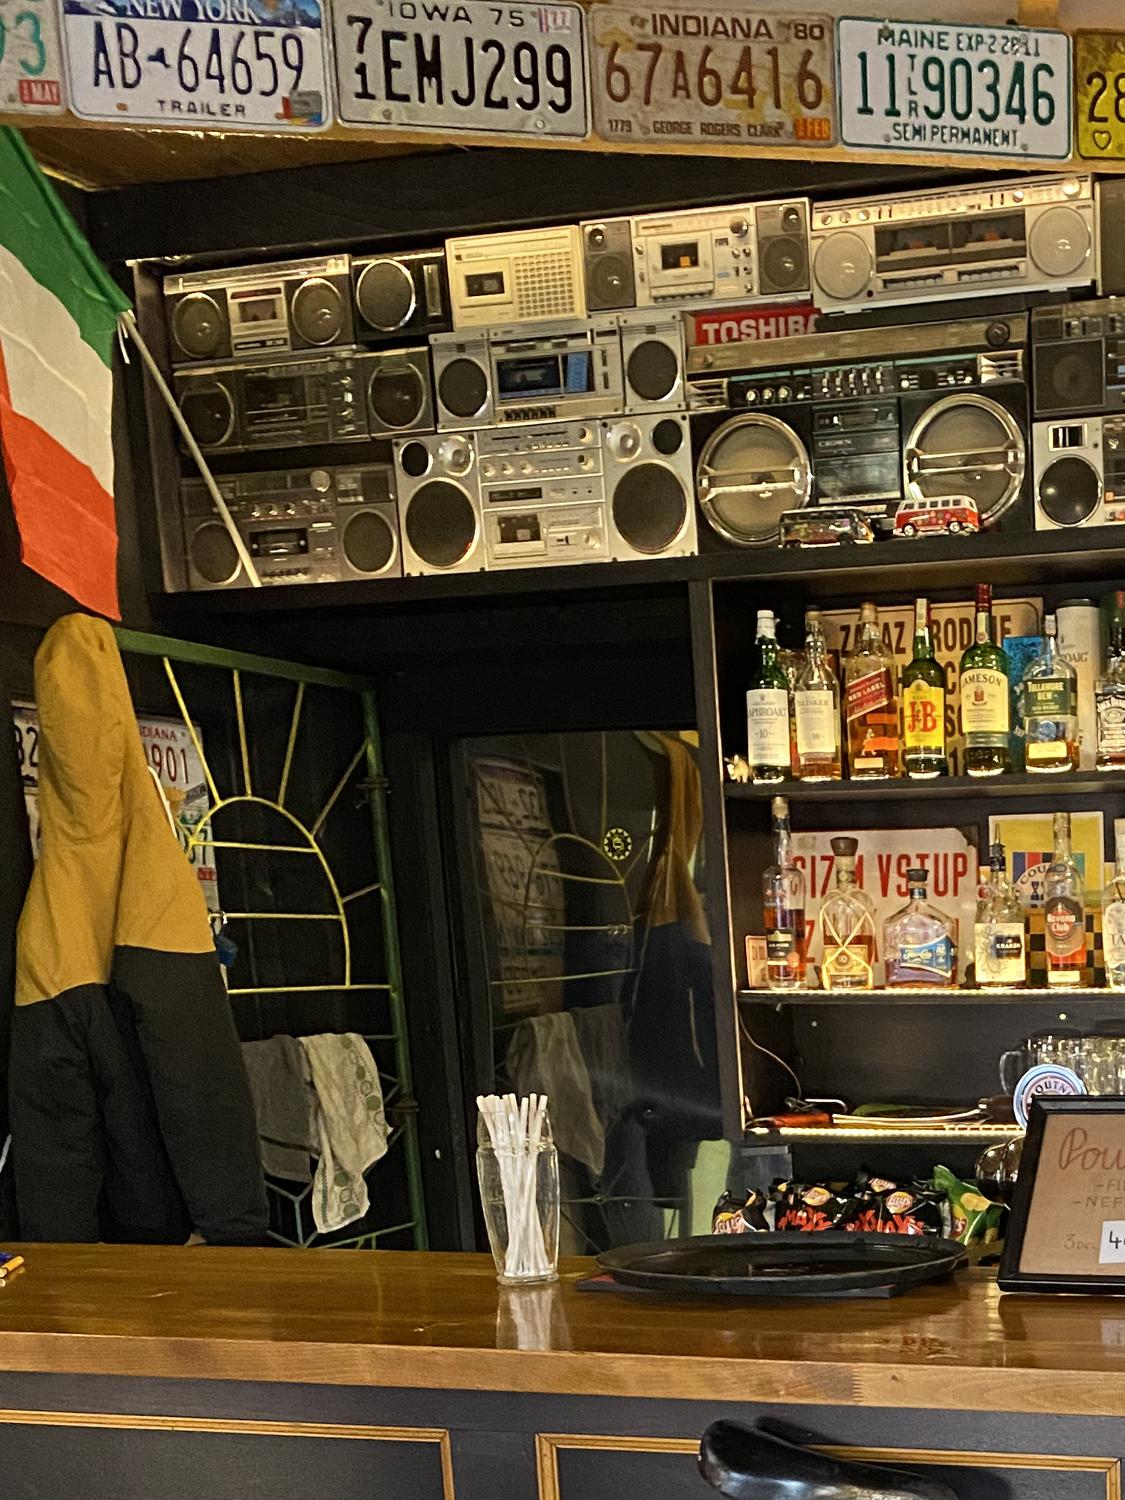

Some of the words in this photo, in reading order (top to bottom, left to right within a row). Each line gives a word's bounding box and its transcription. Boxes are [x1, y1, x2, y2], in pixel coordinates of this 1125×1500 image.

[388, 1, 472, 25] IOWA
[489, 8, 525, 28] 75
[652, 13, 773, 40] INDIANA
[877, 28, 949, 50] MAINE
[381, 30, 573, 114] EMJ299
[606, 42, 823, 109] 67A6416
[157, 99, 246, 117] TRAILER
[653, 120, 693, 135] GEORGE
[700, 121, 741, 137] ROGERS
[747, 124, 784, 137] CLARK
[893, 123, 926, 141] SEMI
[931, 125, 1018, 147] PERMANENT
